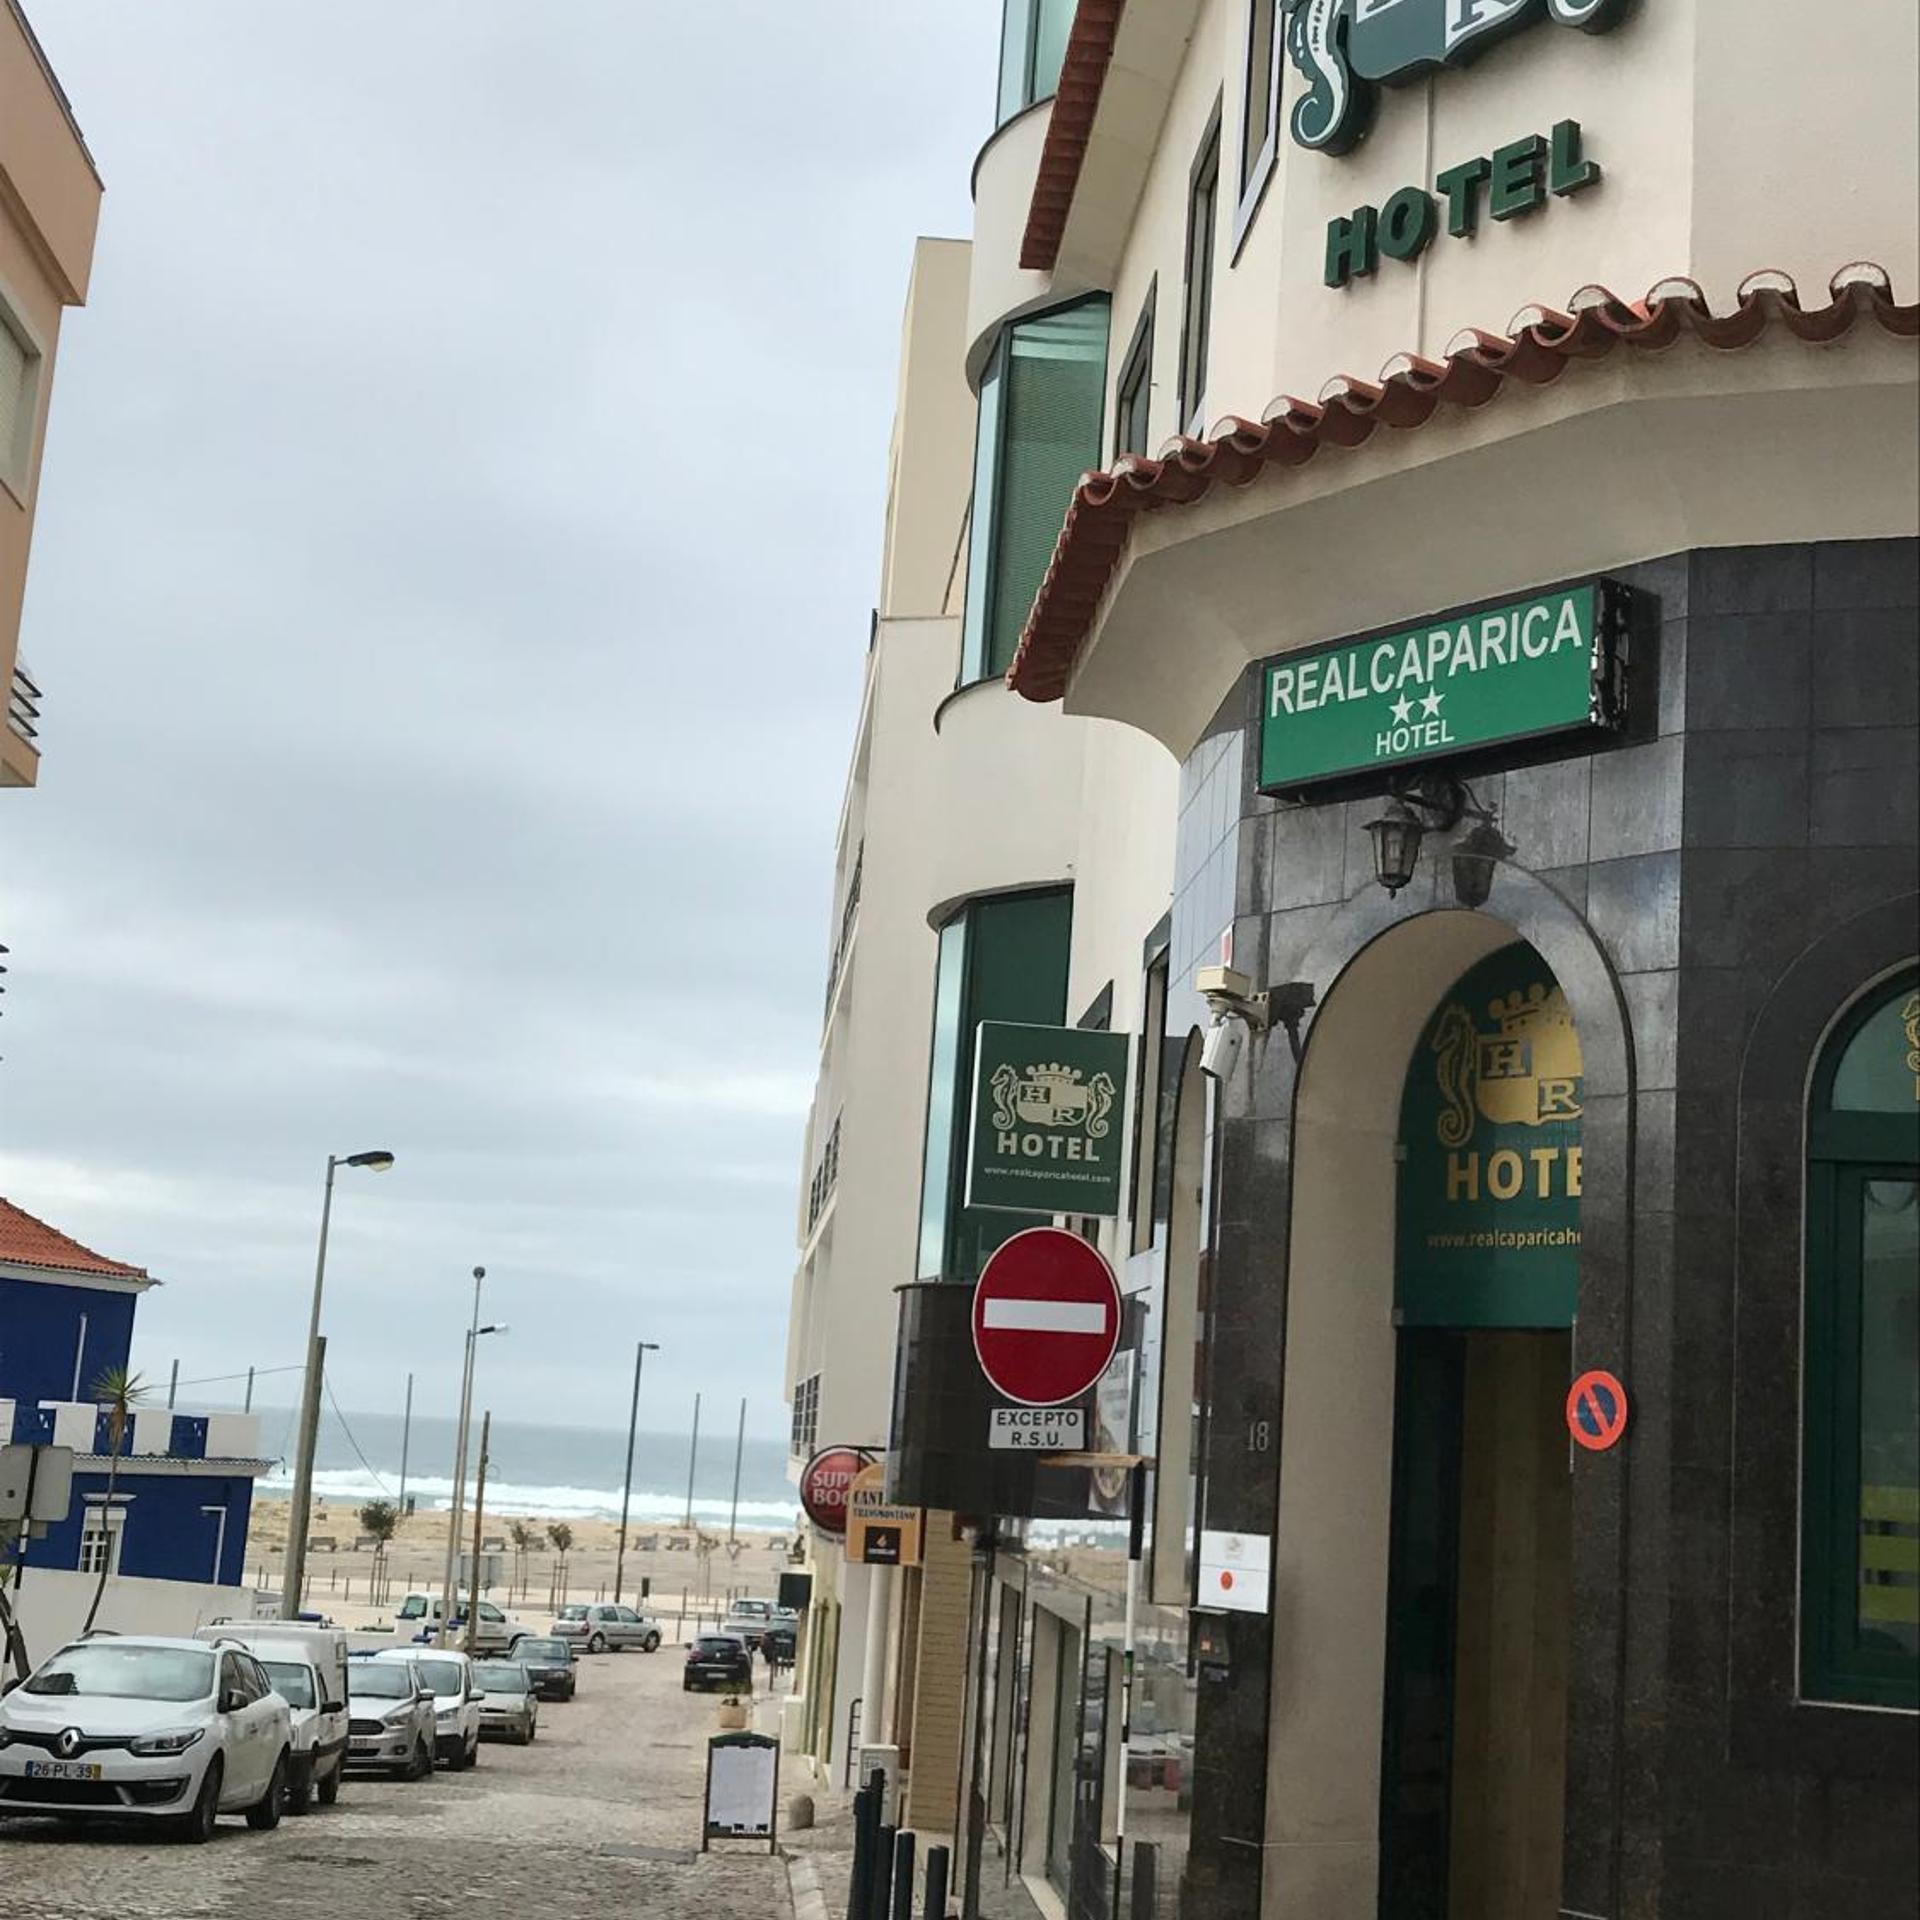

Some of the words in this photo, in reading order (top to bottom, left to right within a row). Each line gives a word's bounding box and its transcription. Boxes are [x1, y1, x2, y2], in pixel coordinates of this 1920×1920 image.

[1325, 119, 1600, 288] HOTEL
[1376, 720, 1454, 756] HOTEL
[997, 1131, 1100, 1162] HOTEL
[996, 1411, 1079, 1427] EXCEPTO
[1011, 1431, 1064, 1447] R.S.U.
[1248, 1420, 1269, 1452] 18
[53, 1764, 71, 1778] PL
